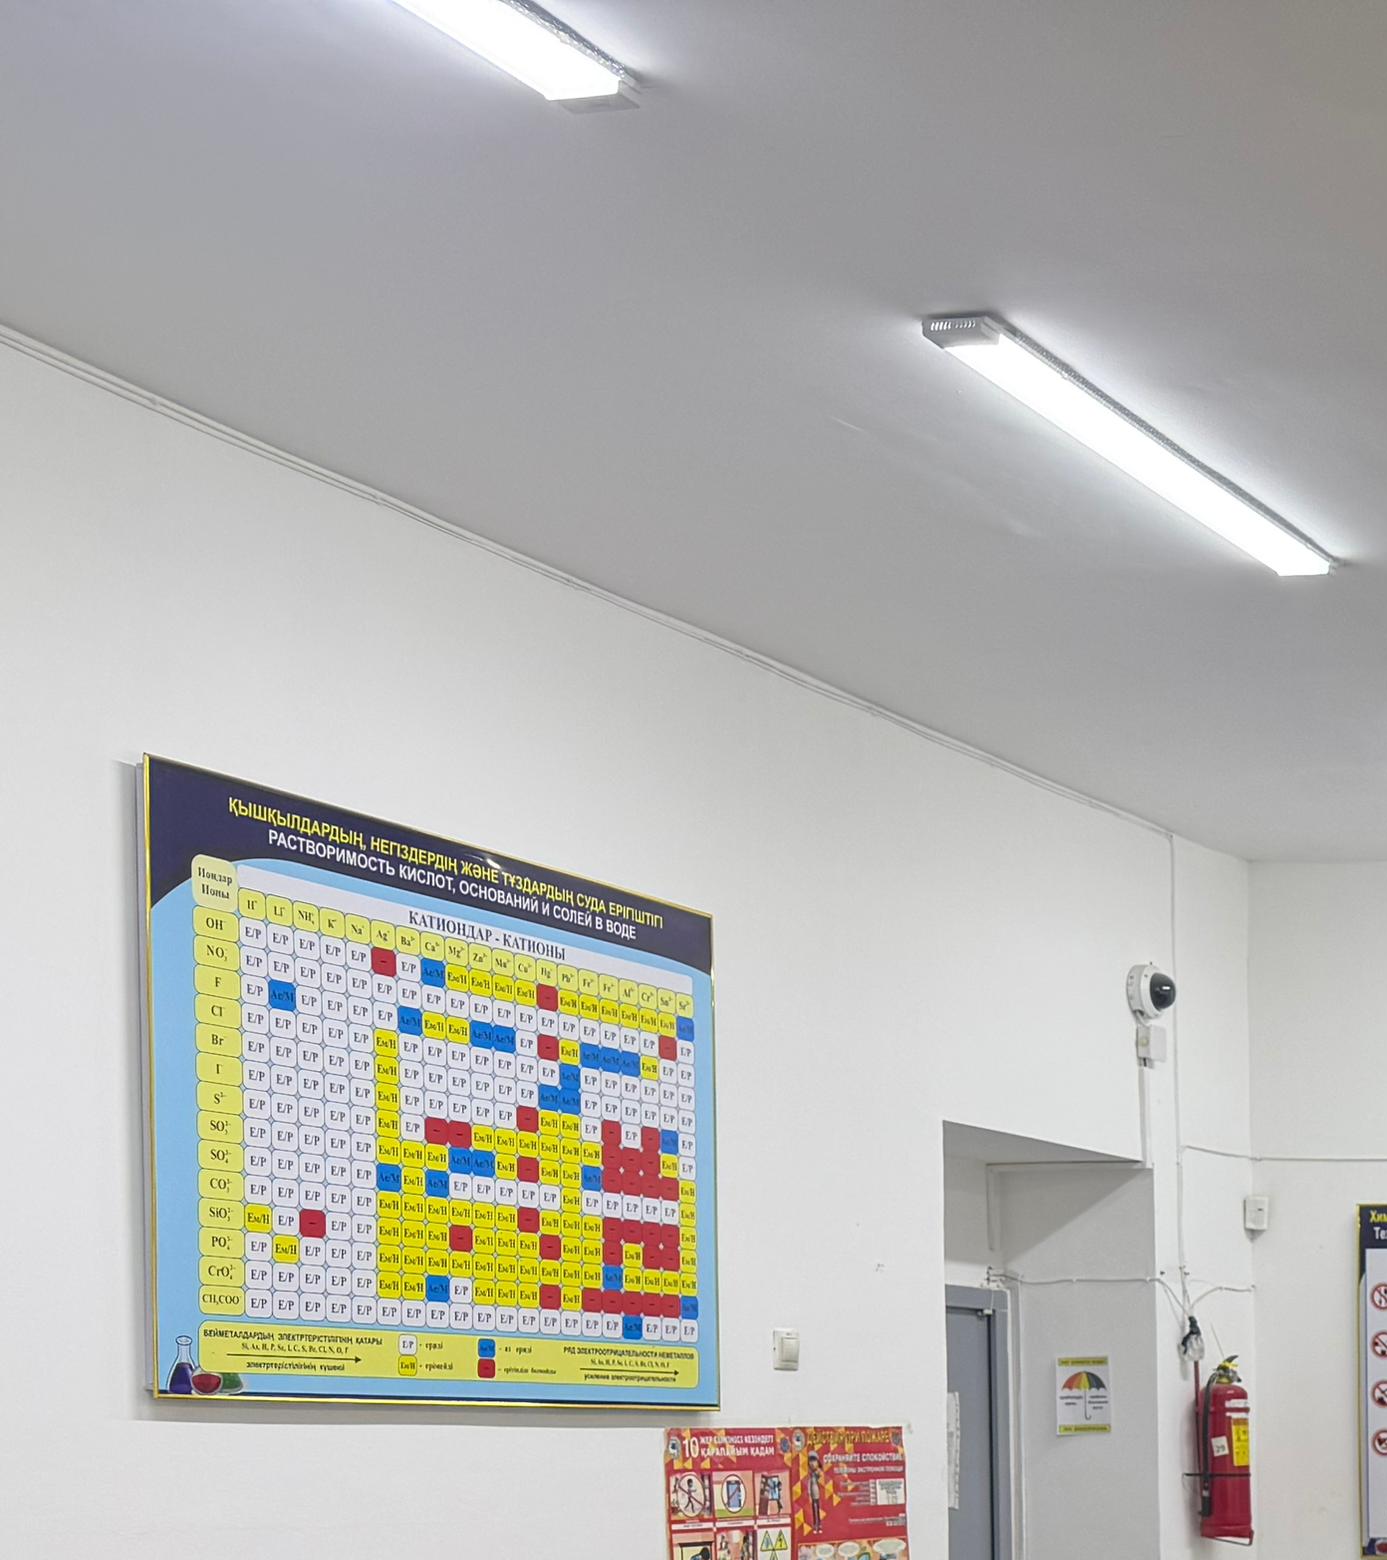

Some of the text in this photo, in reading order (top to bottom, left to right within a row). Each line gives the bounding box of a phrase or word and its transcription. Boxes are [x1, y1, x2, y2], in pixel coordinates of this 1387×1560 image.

[269, 830, 637, 940] РАСТВОРИМОСТЬ КИСЛОТ, ОСНОВАНИЙ И СОЛЕЙ В ВОДЕ
[461, 860, 499, 884] ЖӘНЕ
[577, 892, 606, 914] СУДА
[409, 910, 492, 945] КАТИОНДАР
[503, 934, 566, 961] КАТИОНЫ
[682, 1436, 699, 1458] 10
